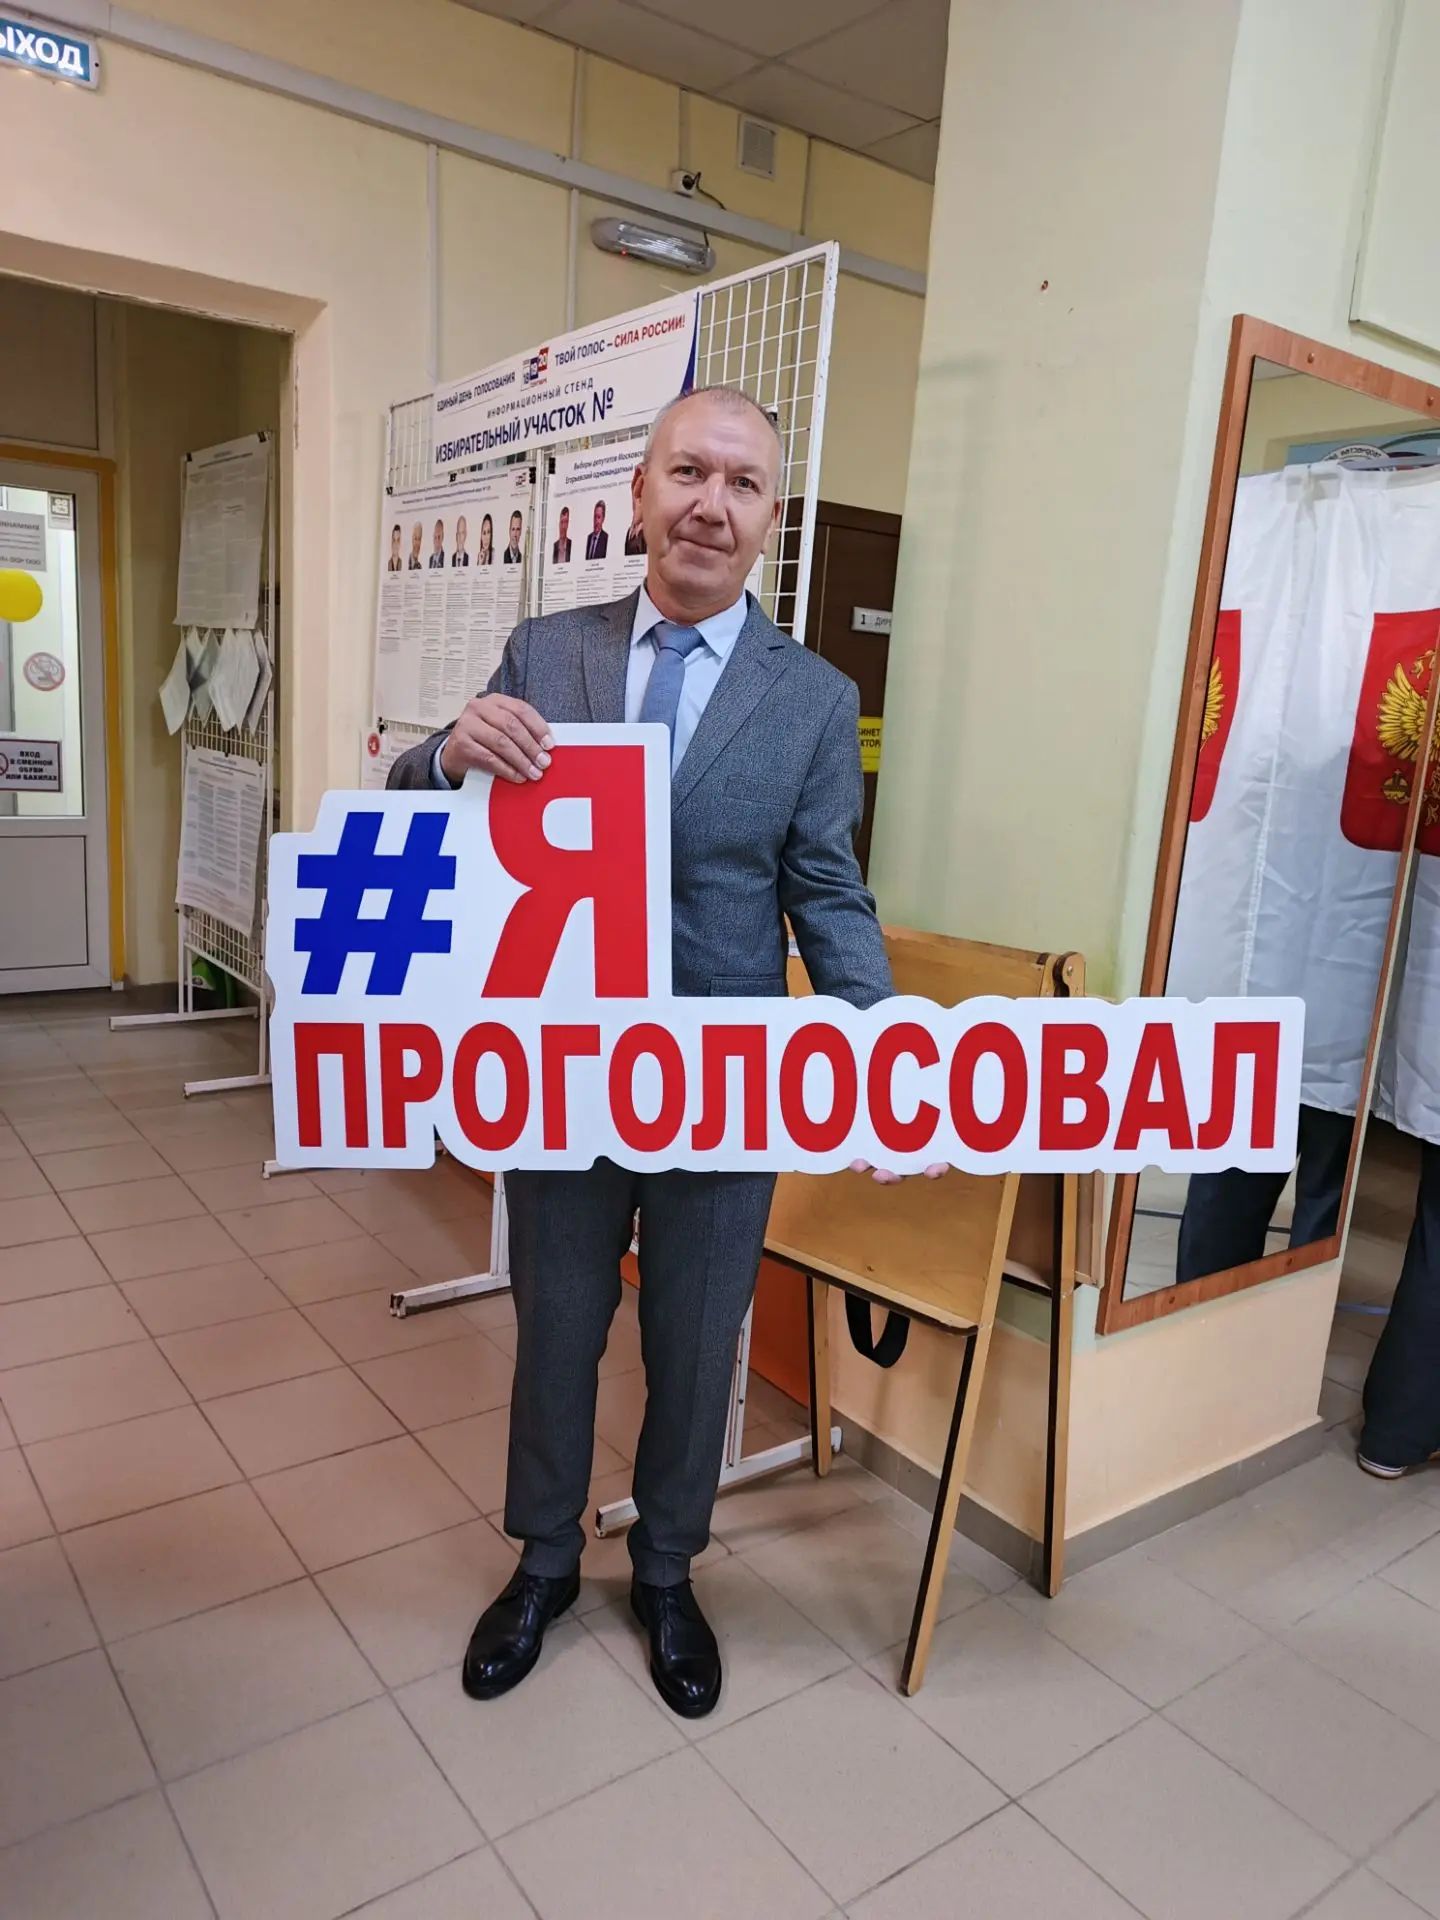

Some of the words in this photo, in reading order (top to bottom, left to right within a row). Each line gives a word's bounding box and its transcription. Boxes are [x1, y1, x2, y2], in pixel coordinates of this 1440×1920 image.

[554, 346, 576, 366] ТВОЙ
[577, 339, 605, 360] ГОЛОС
[614, 331, 639, 348] СИЛА
[641, 314, 685, 340] РОССИИ!
[437, 391, 458, 412] ЕДИНЫЙ
[459, 390, 472, 404] ДЕНЬ
[474, 371, 515, 397] ГОЛОСОВАНИЯ
[487, 384, 560, 419] ИНФОРМАЦИОННЫЙ
[564, 377, 593, 394] СТЕНД
[435, 416, 521, 464] ИЗБИРАТЕЛЬНЫЙ
[524, 401, 586, 439] УЧАСТОК
[592, 387, 614, 422] №
[294, 1022, 1280, 1153] ПРОГОЛОСОВАЛ
